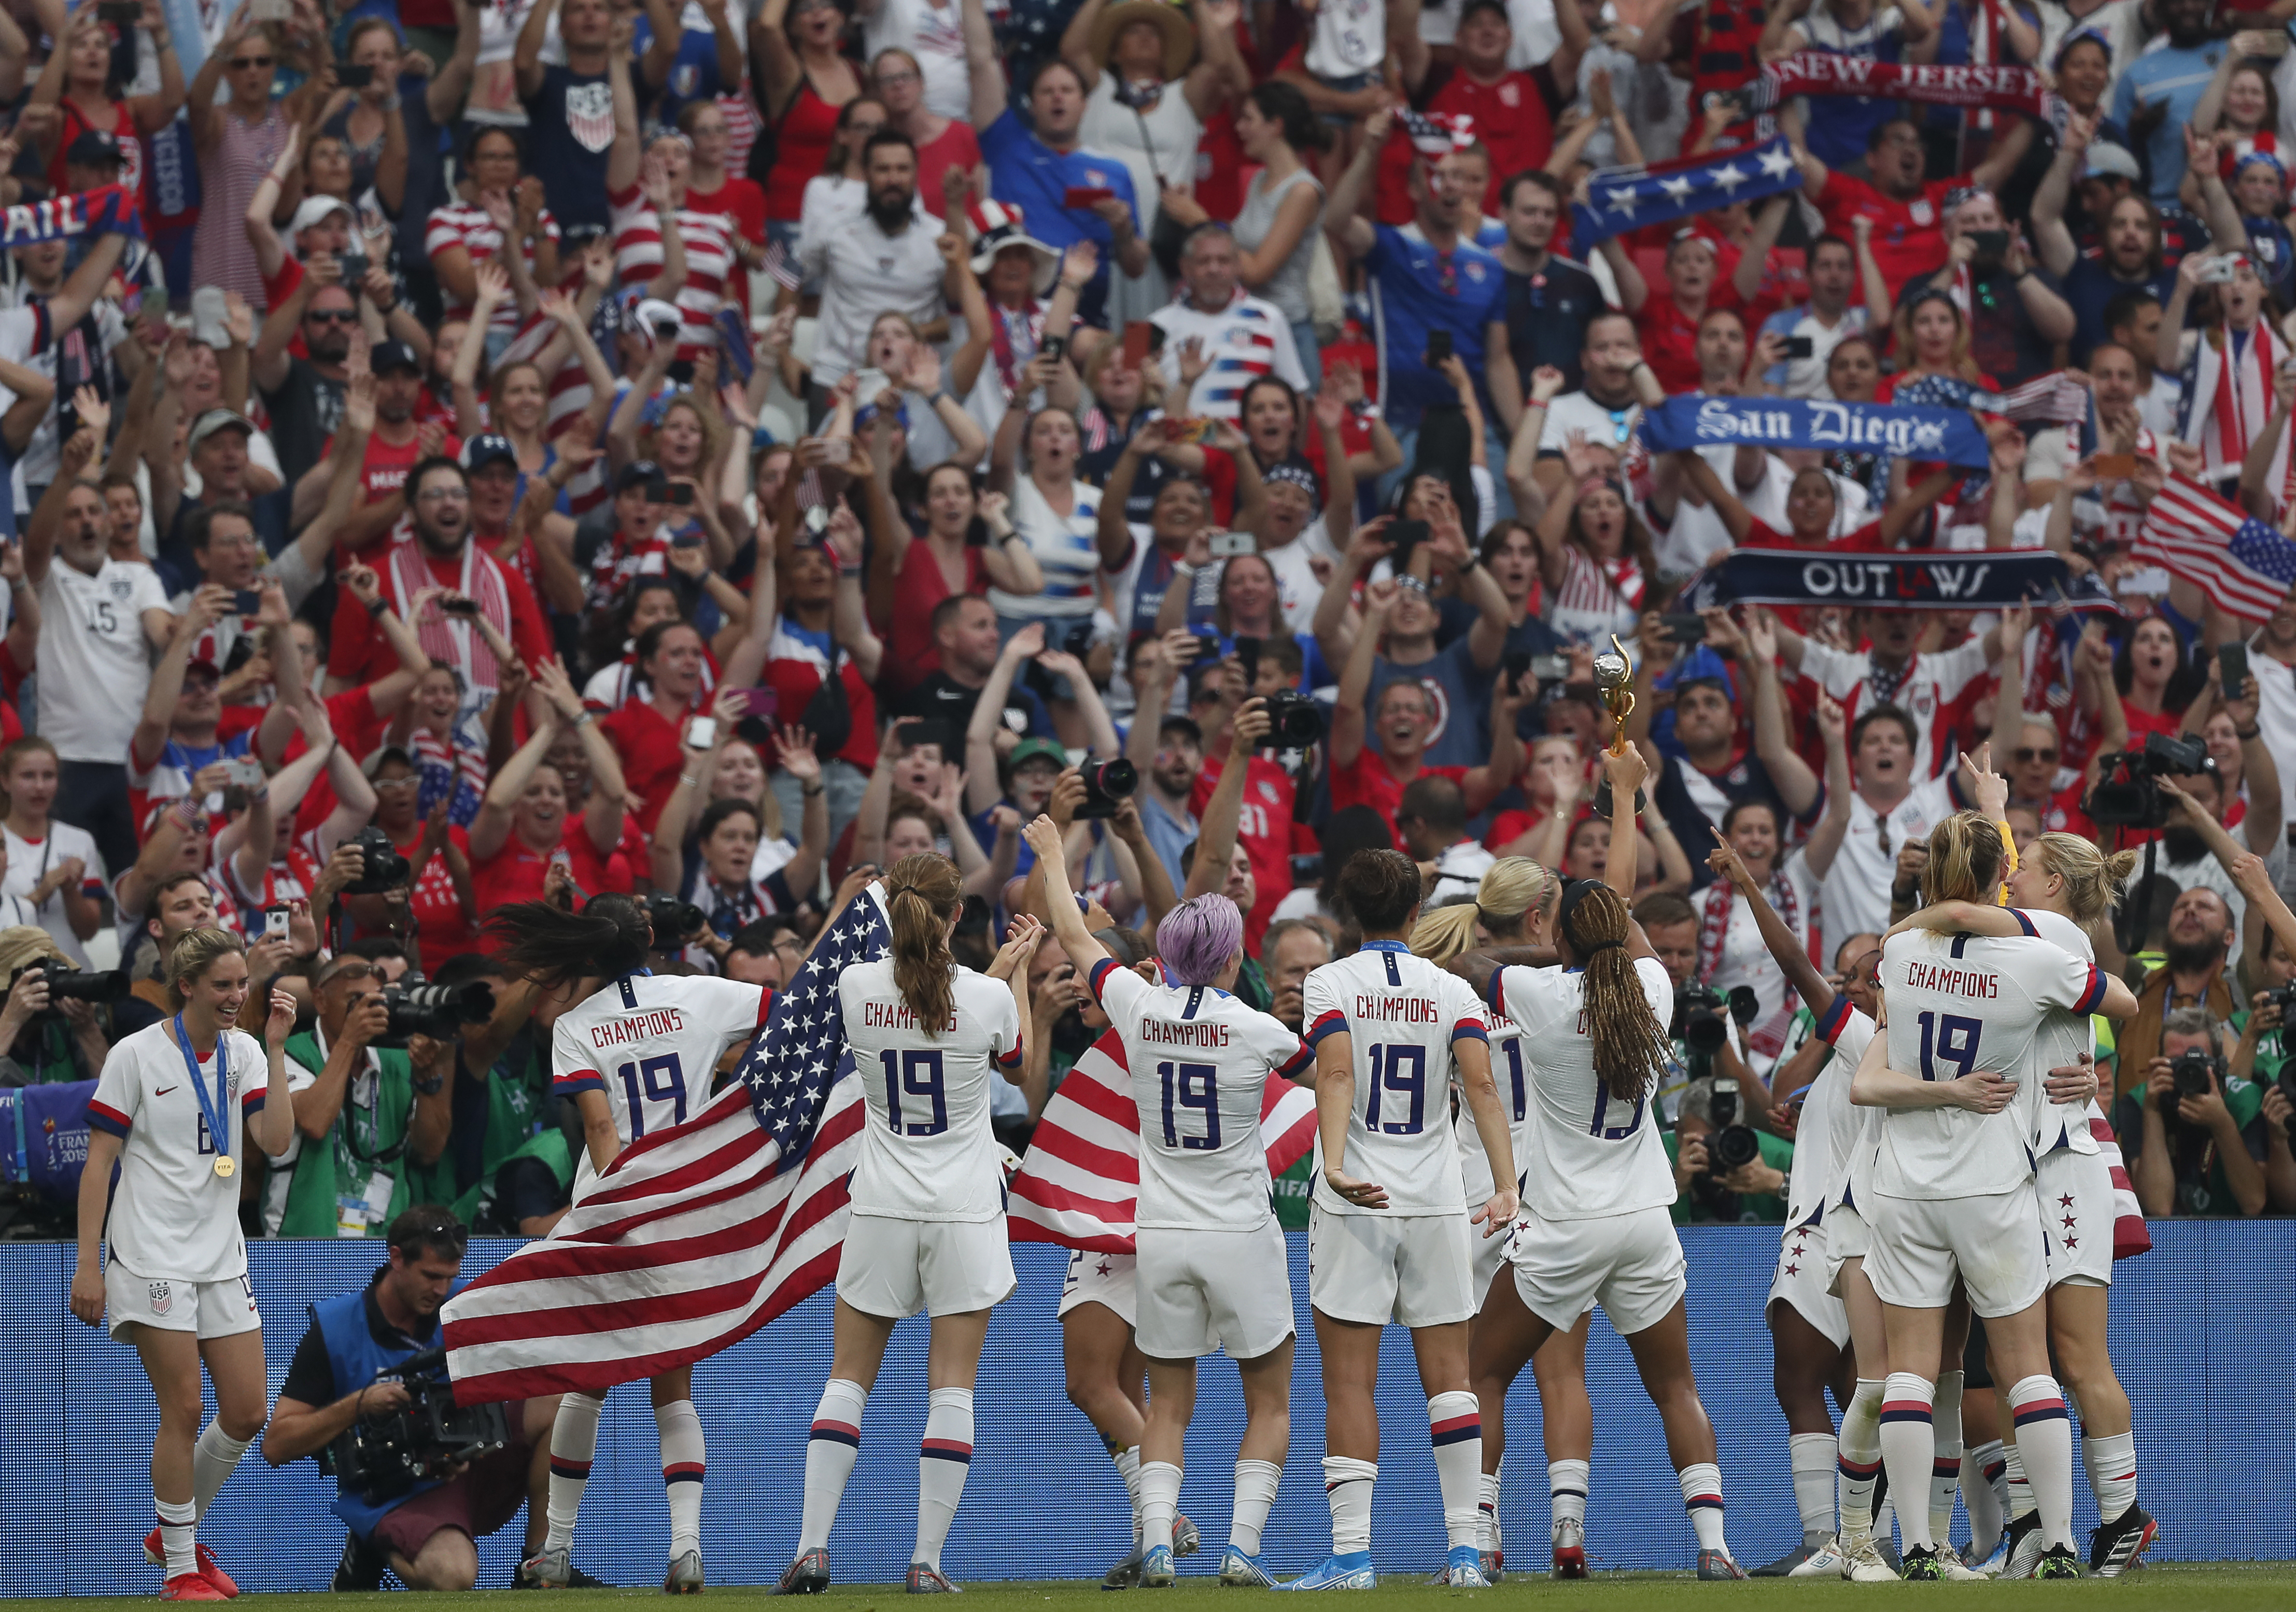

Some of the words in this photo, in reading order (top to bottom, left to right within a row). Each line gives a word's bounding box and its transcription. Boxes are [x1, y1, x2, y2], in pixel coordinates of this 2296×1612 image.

[1779, 52, 1873, 83] NEW
[1892, 63, 2040, 97] JERSEY
[1696, 399, 1794, 440] San
[1802, 561, 1991, 598] OUTLAWS
[1908, 962, 1998, 999] CHAMPIONS
[590, 1008, 683, 1048] CHAMPIONS
[863, 1002, 957, 1032] CHAMPS
[1357, 995, 1439, 1023] CHAMPIONS
[1143, 1019, 1229, 1048] CHAMPIONS
[1917, 1011, 1983, 1082] 19
[618, 1052, 687, 1144] 19
[879, 1049, 948, 1136] 19
[1157, 1061, 1222, 1150] 19
[1365, 1043, 1426, 1135] 19
[61, 1149, 88, 1163] 2019
[151, 1288, 168, 1300] USA
